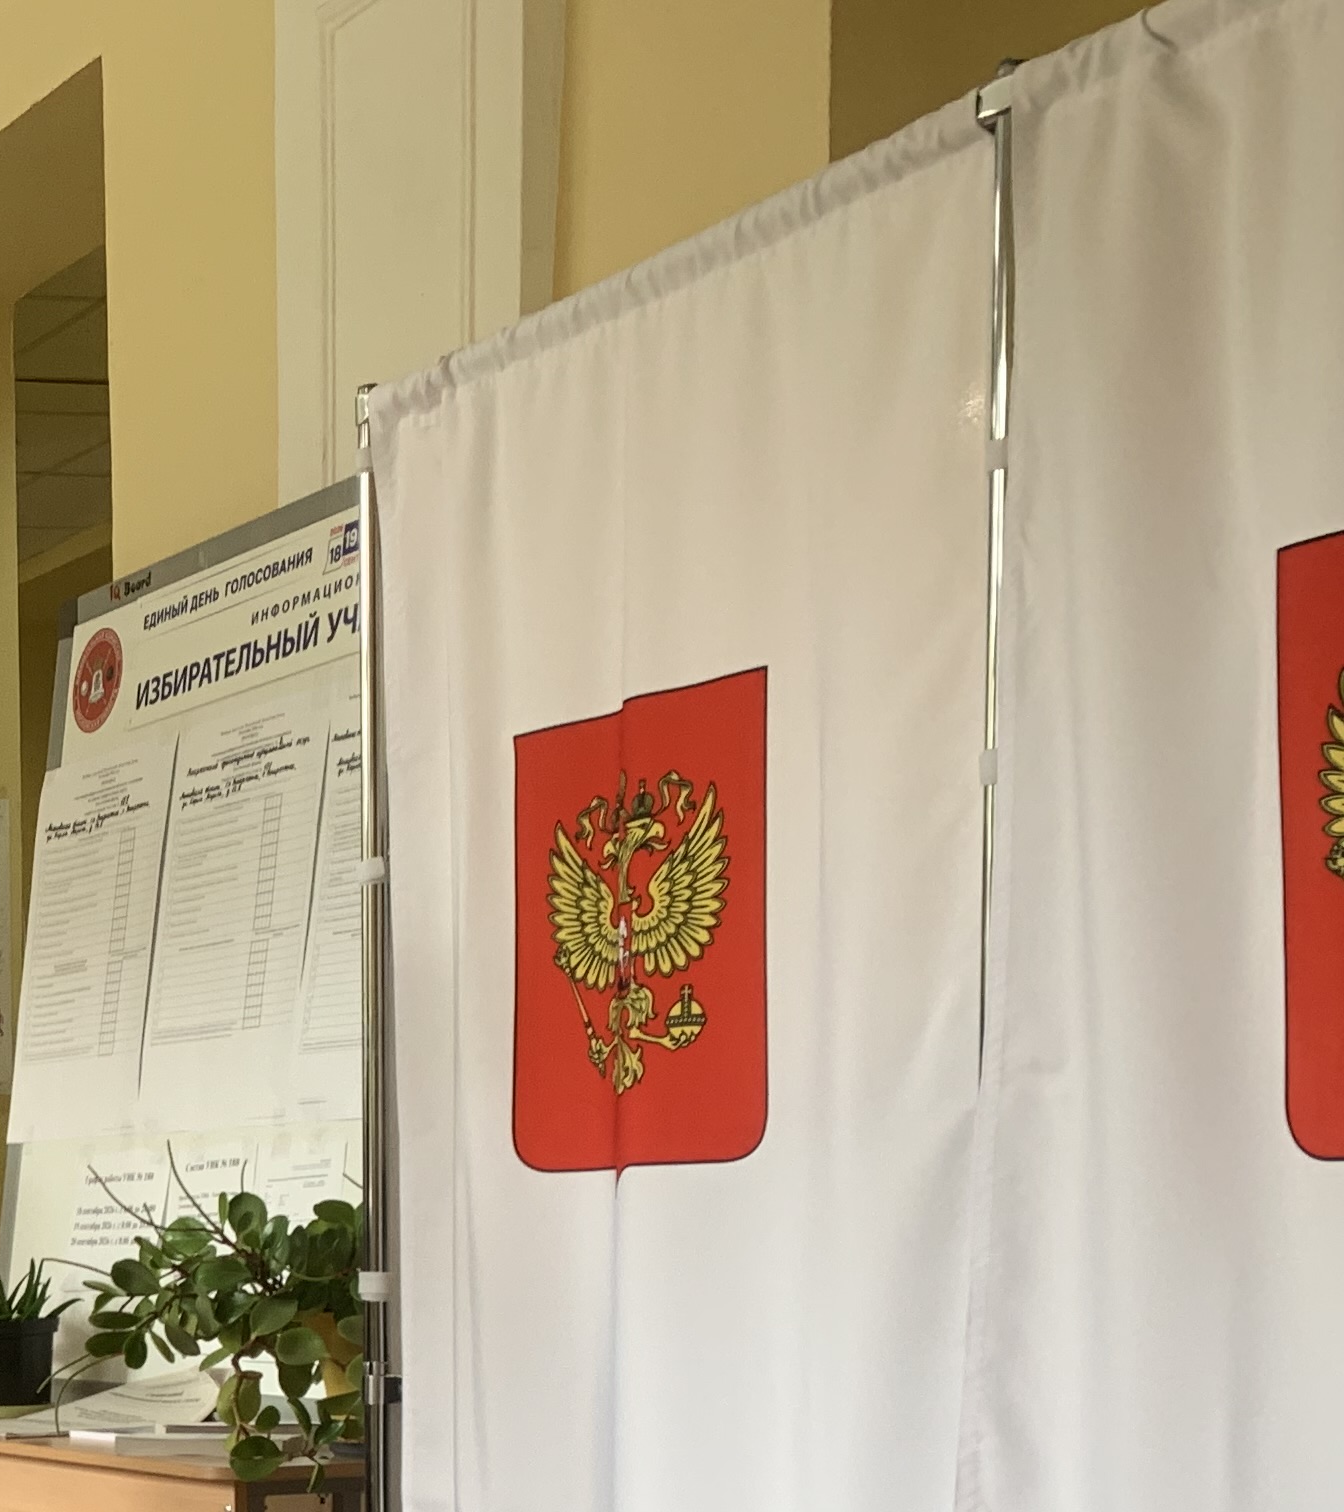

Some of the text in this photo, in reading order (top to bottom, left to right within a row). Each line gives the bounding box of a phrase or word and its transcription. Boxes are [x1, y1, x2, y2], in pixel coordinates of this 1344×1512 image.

[330, 545, 341, 564] 18
[345, 528, 358, 549] 19
[143, 547, 313, 630] ЕДИНЫЙ ДЕНЬ ГОЛОСОВАНИЯ
[136, 611, 320, 710] ИЗБИРАТЕЛЬНЫЙ
[327, 602, 360, 644] УЧ
